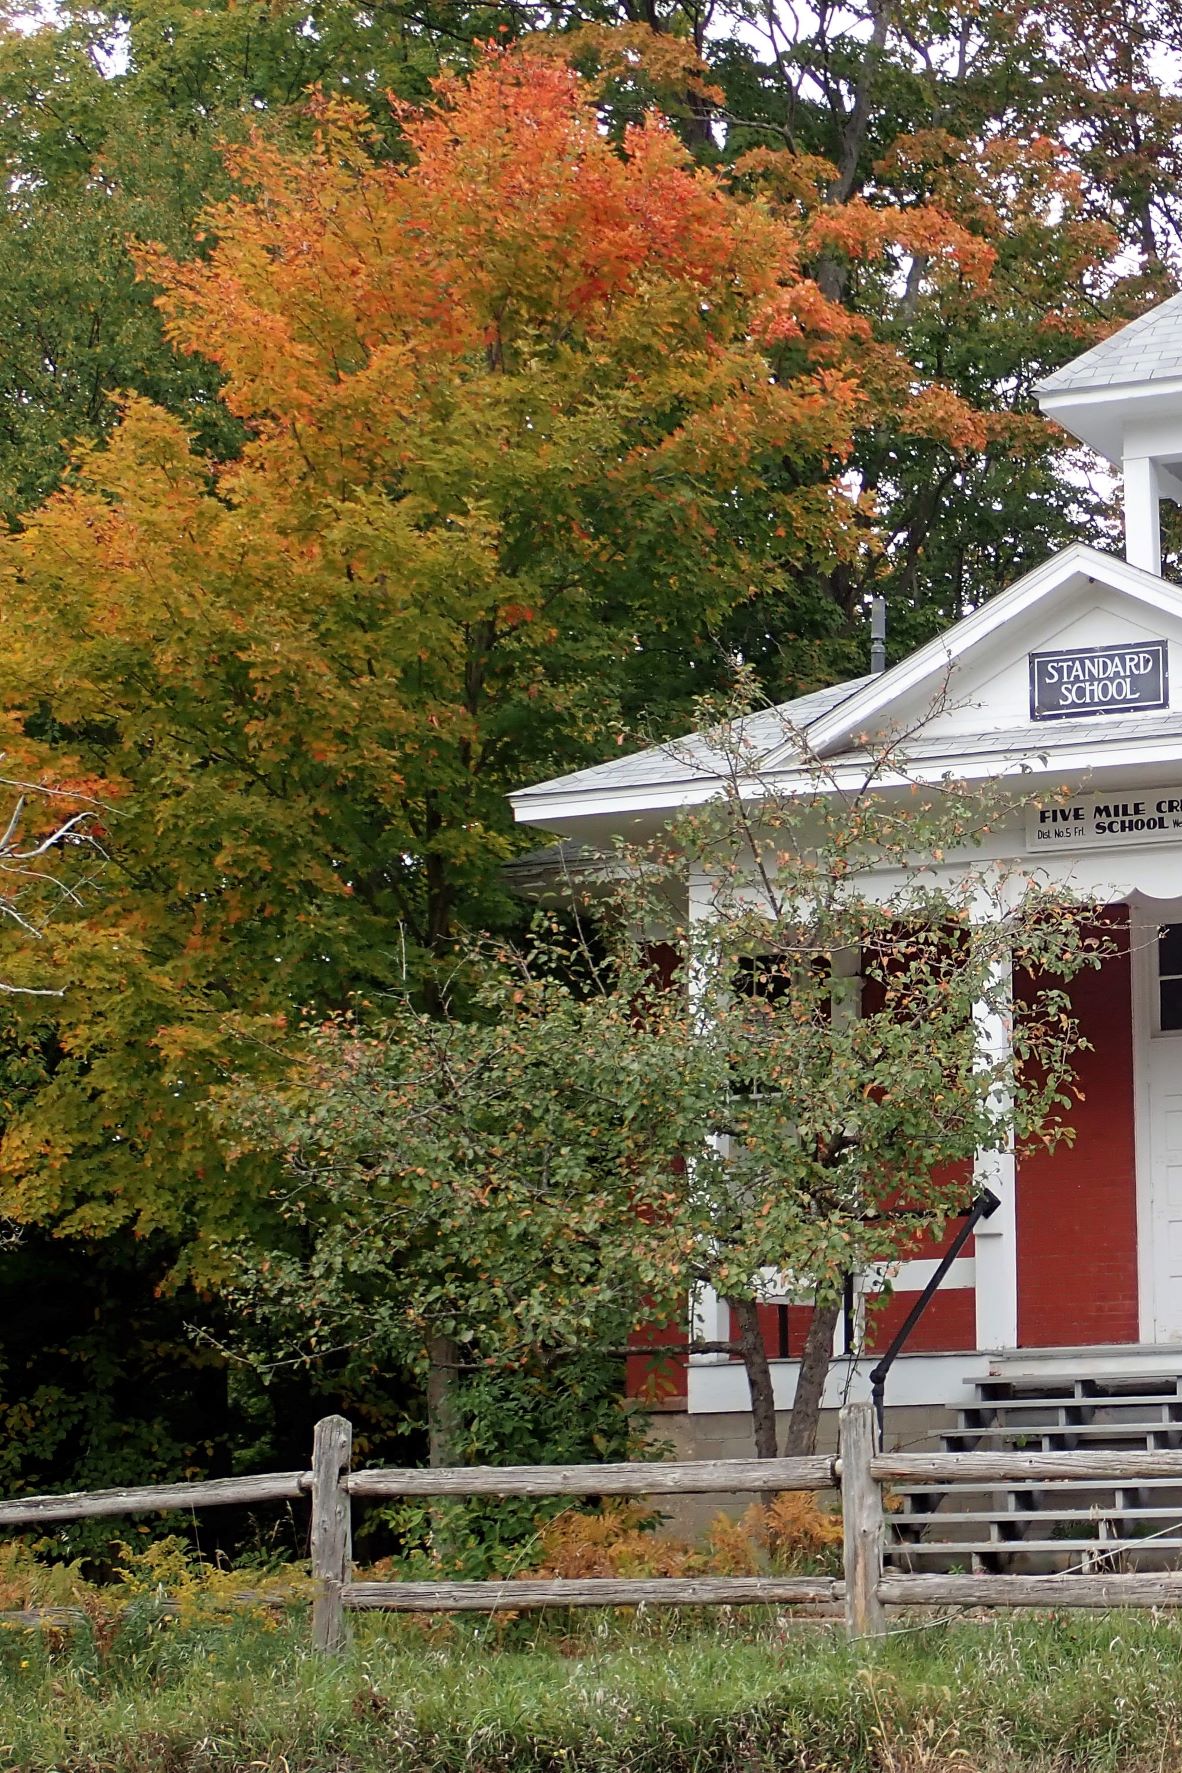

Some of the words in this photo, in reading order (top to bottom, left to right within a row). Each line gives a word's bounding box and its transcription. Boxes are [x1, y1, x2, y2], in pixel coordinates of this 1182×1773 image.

[1045, 653, 1153, 683] STANDARD
[1059, 678, 1140, 705] SCHOOL
[1040, 807, 1085, 823] FIVE
[1094, 803, 1146, 819] MILE
[1095, 817, 1169, 835] SCHOOL
